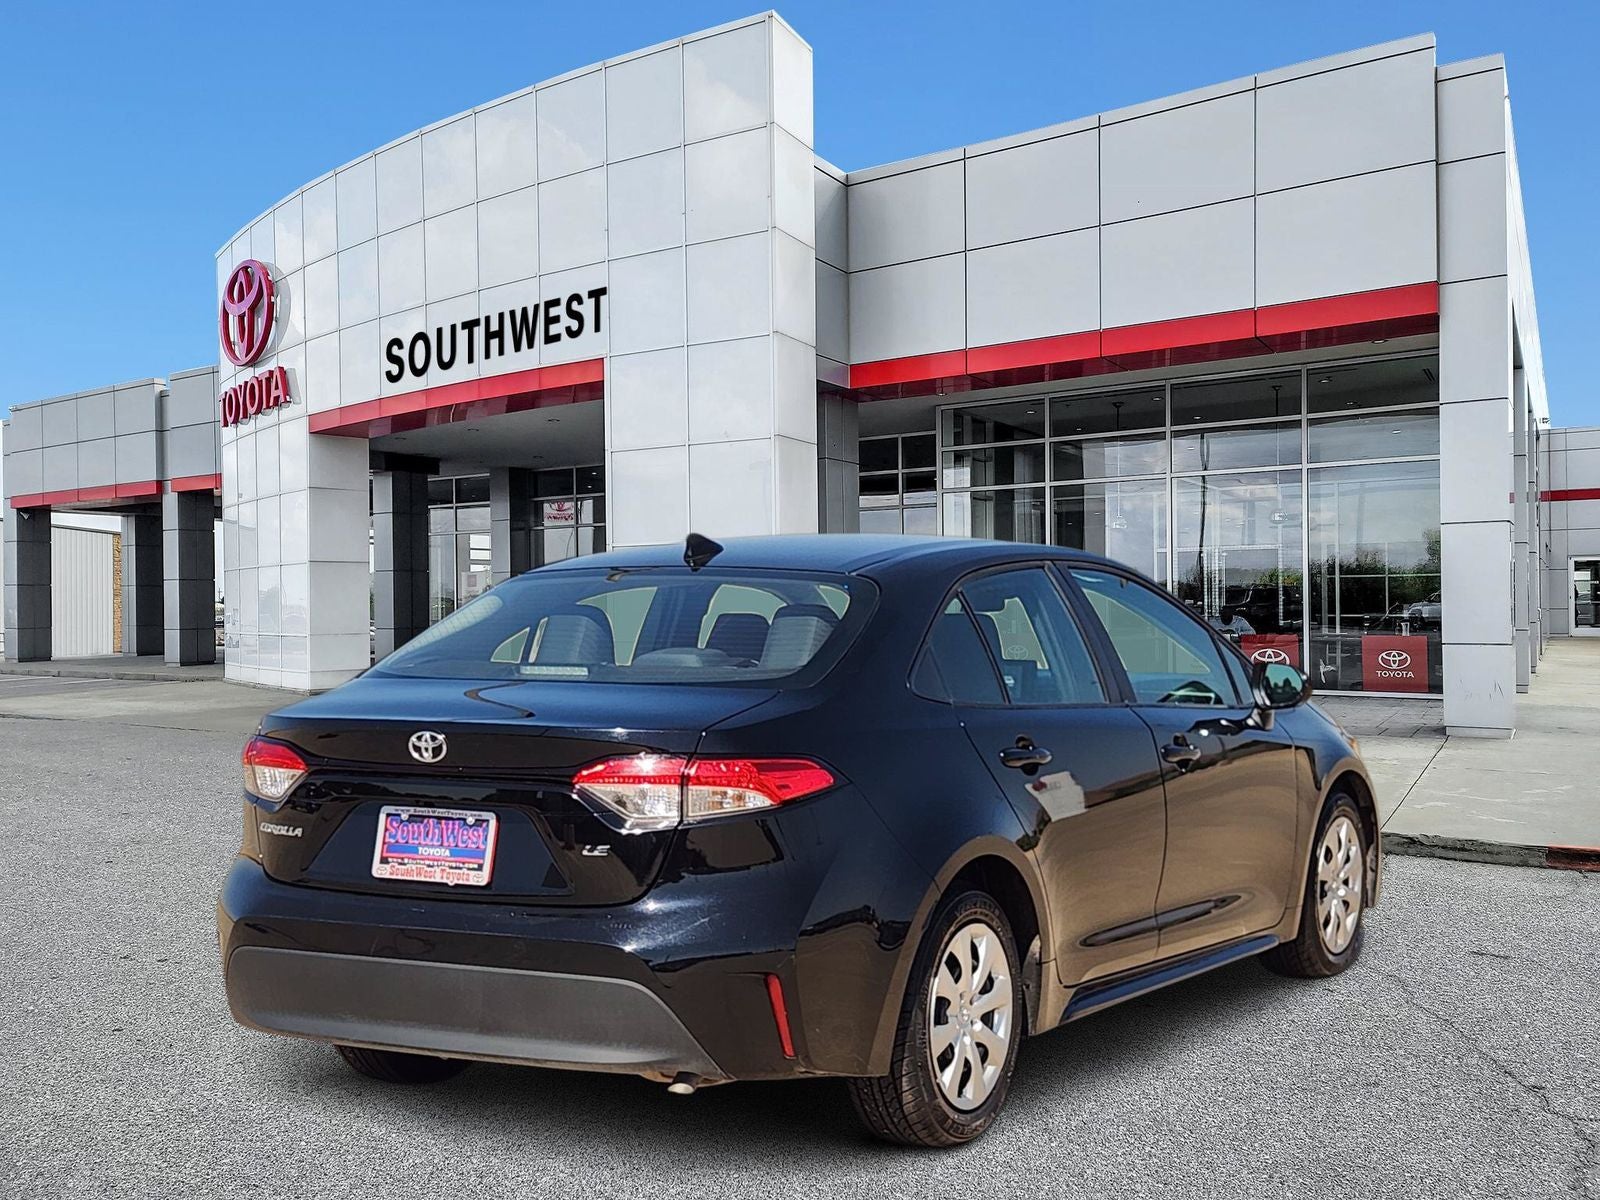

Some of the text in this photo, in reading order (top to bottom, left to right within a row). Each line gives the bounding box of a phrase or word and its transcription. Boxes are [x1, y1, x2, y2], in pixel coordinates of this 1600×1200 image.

[385, 286, 607, 383] SOUTHWEST
[219, 366, 291, 427] TOYOTA
[1376, 670, 1415, 678] TOYOTA
[385, 816, 488, 849] SouthWest
[418, 846, 451, 857] TOYOTA
[582, 845, 611, 856] LE
[440, 868, 471, 883] Toyota
